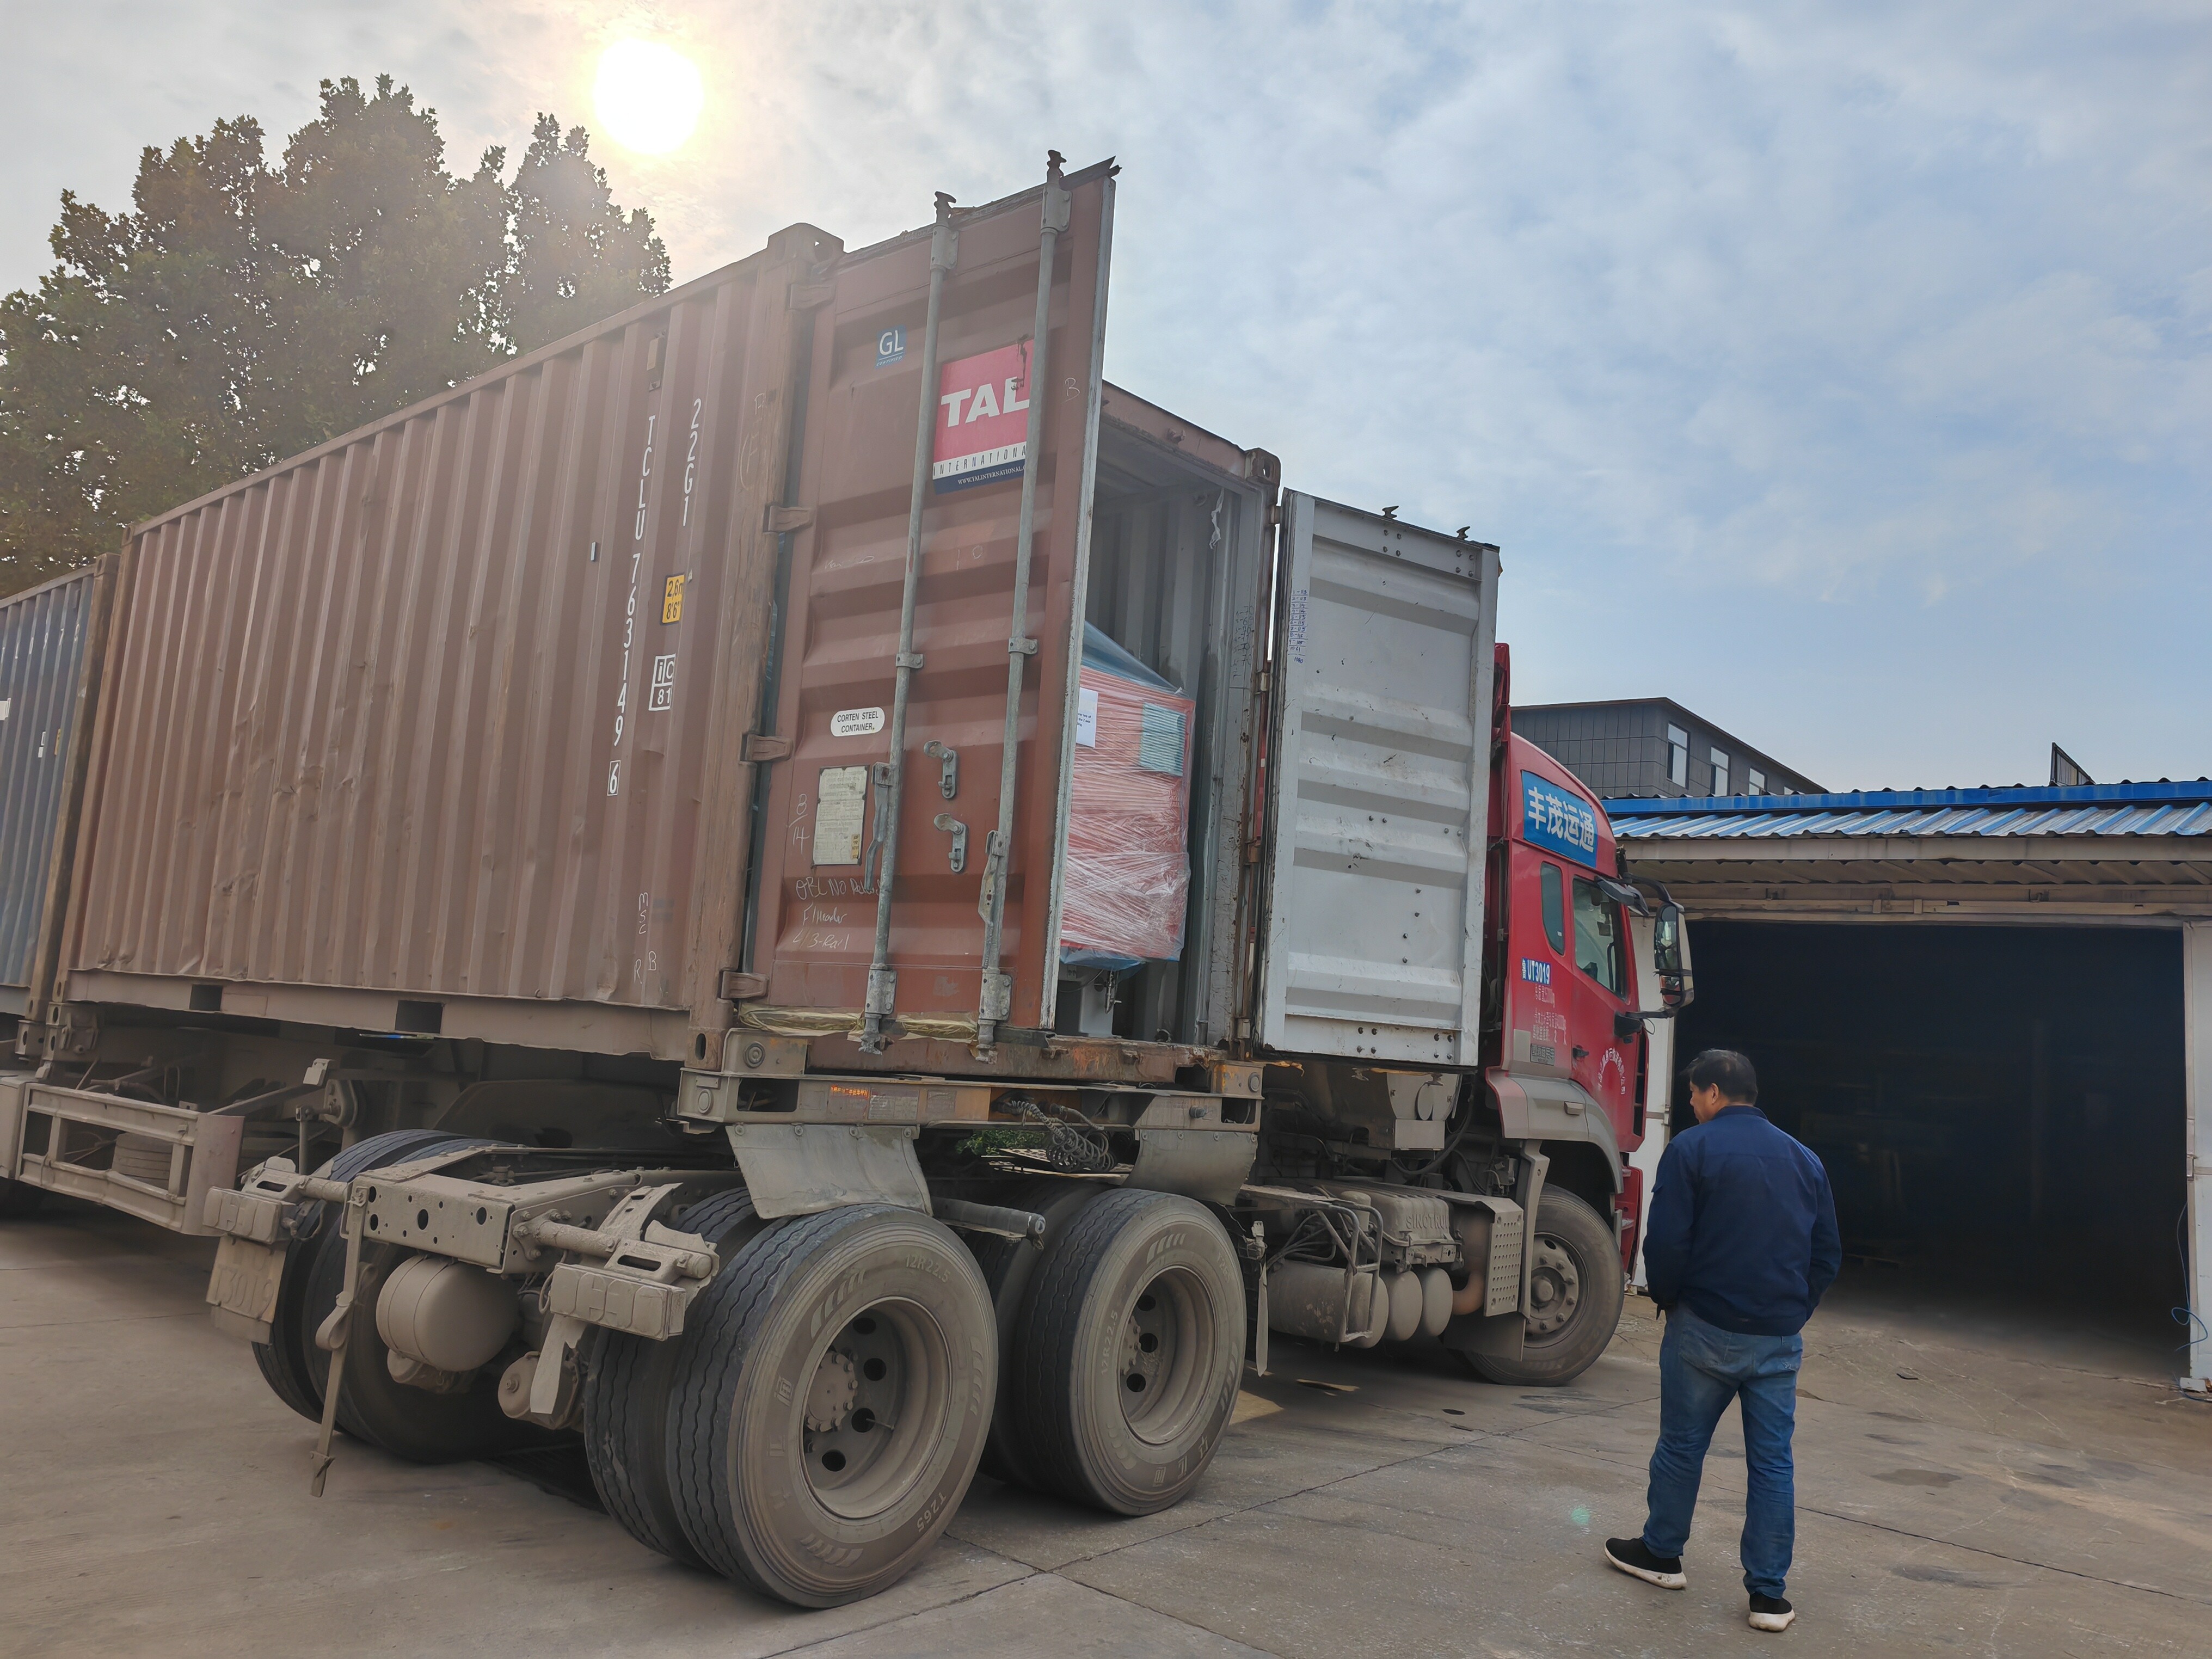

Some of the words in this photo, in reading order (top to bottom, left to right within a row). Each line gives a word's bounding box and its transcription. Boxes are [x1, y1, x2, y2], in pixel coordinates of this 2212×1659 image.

[879, 330, 904, 355] GL
[941, 376, 1030, 428] TAL
[635, 415, 655, 540] TCLU
[683, 398, 702, 526] 22G1
[933, 445, 1026, 476] INTERNATIONA
[957, 465, 1025, 485] WWW.TALINTERNATIONAL.
[613, 552, 641, 746] 763149
[657, 687, 671, 705] 81
[837, 712, 860, 723] CORTEN
[862, 711, 879, 720] STEEL
[1528, 786, 1594, 853] 丰茂运通
